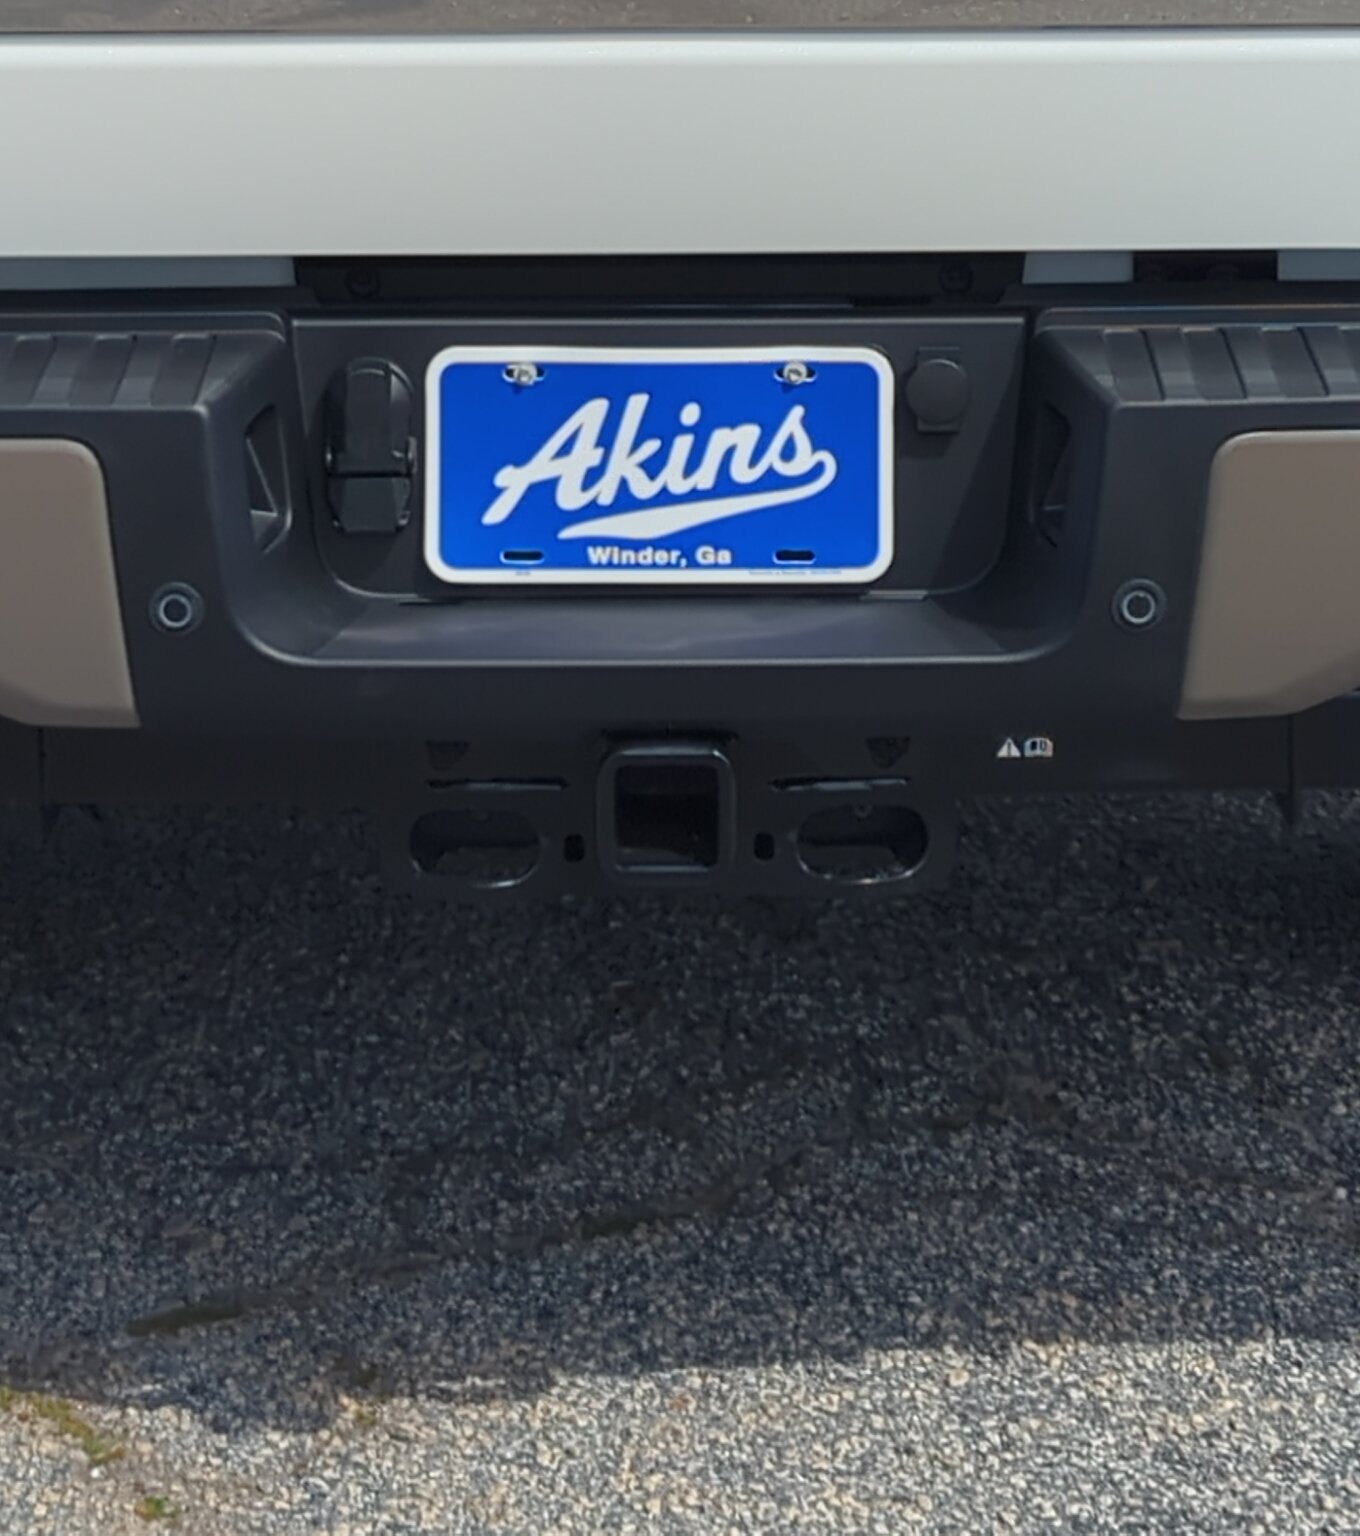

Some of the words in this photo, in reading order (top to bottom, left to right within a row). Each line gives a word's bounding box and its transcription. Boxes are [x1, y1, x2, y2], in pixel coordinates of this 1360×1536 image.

[480, 392, 838, 530] Akins
[586, 545, 688, 568] Winder,
[694, 545, 734, 566] Ga
